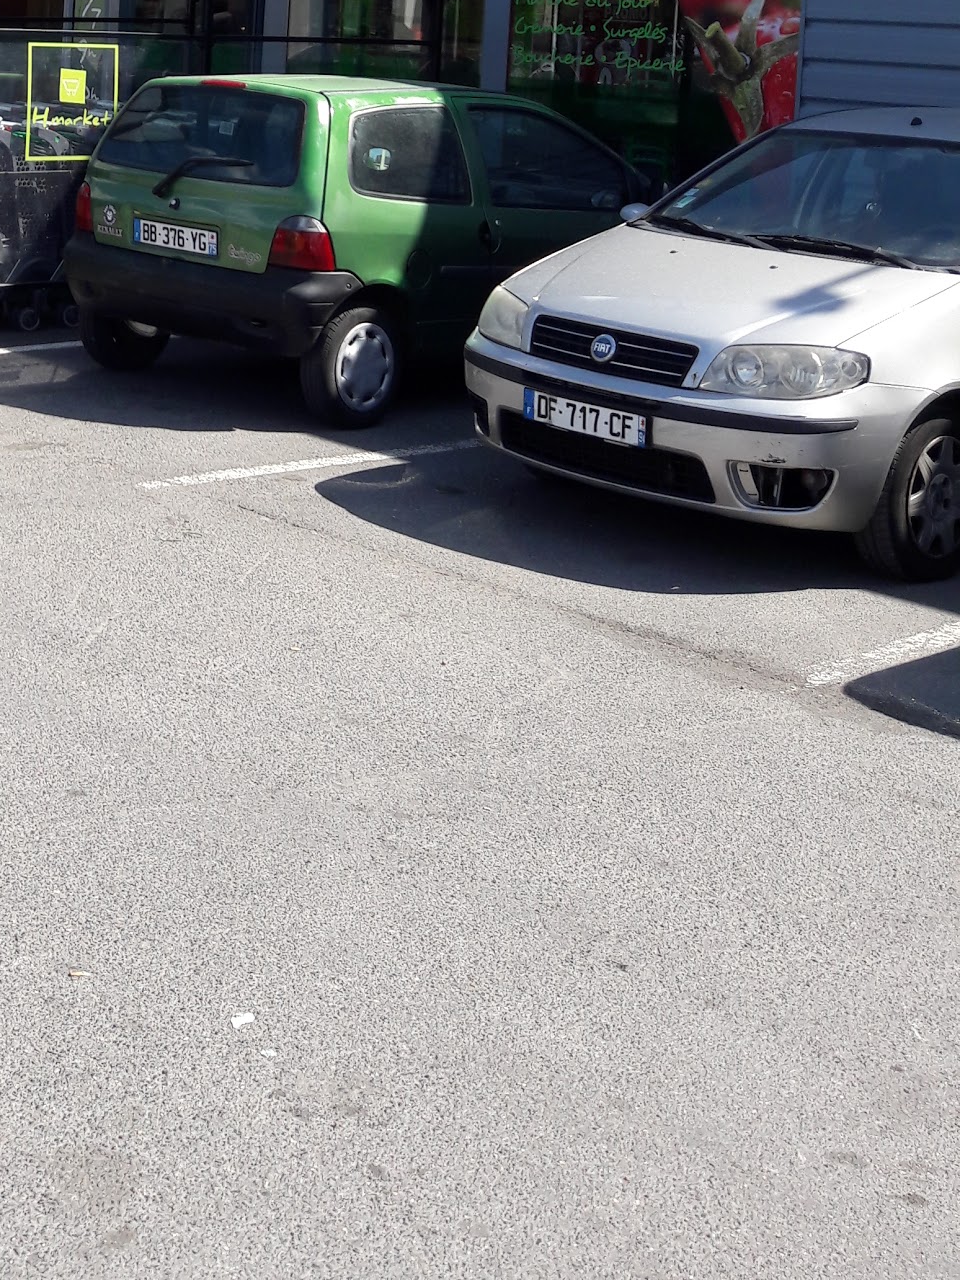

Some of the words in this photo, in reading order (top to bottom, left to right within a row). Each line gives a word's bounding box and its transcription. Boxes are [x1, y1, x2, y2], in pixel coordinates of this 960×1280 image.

[602, 16, 669, 46] Surgelés
[513, 43, 596, 66] Boucherie
[593, 341, 611, 354] FIAT
[537, 394, 634, 439] DF-717-CF
